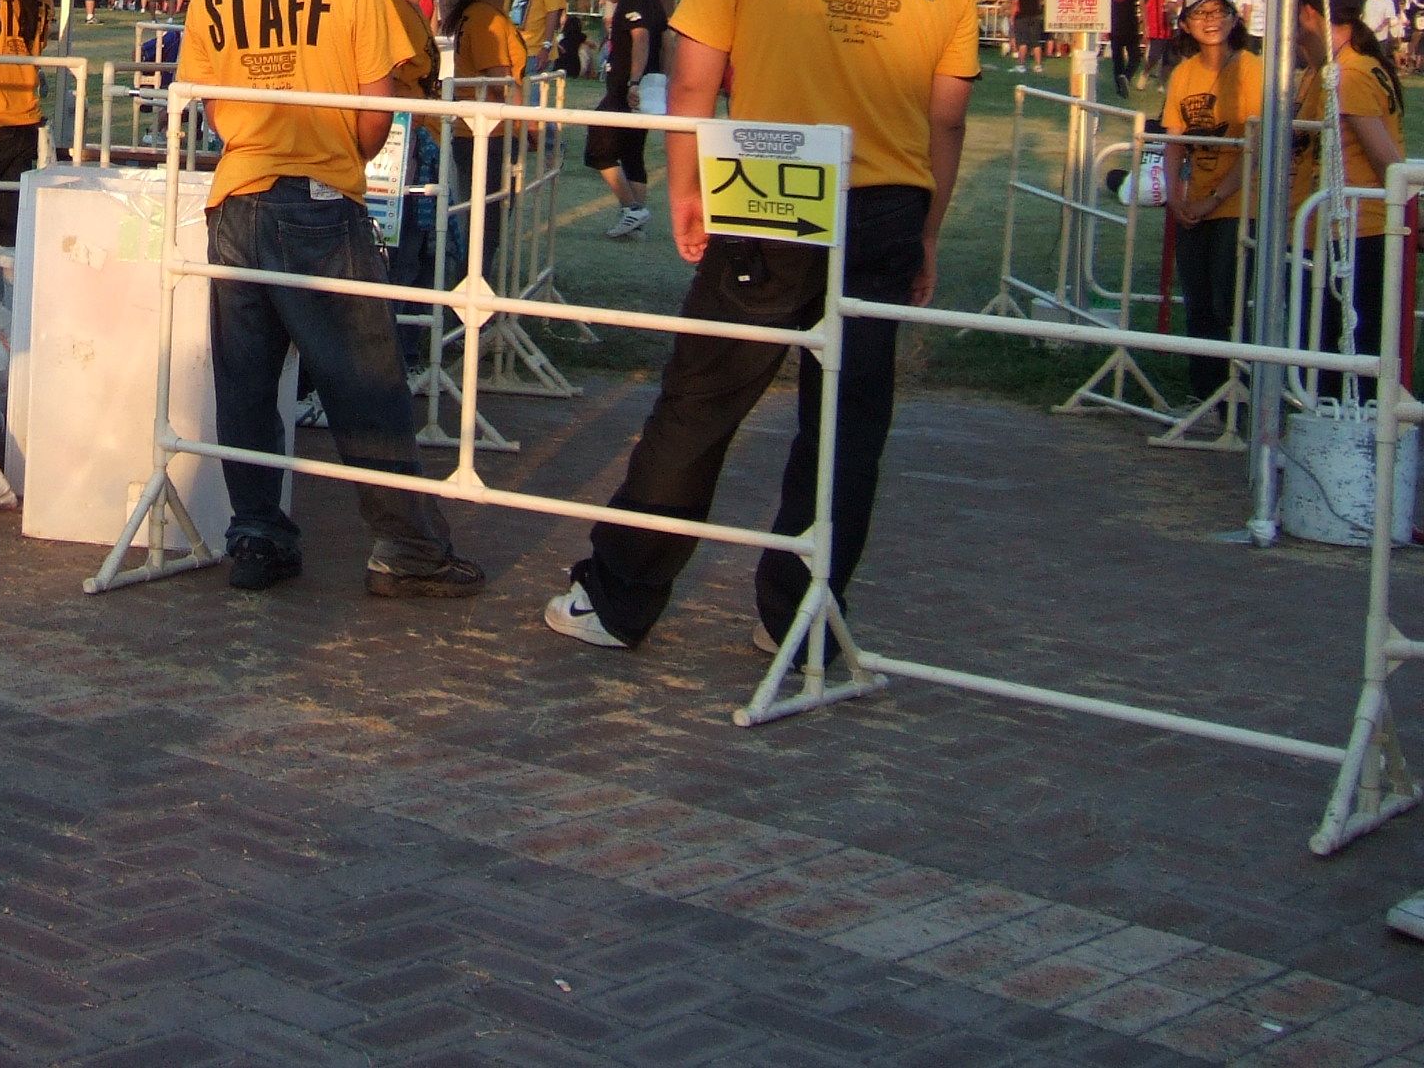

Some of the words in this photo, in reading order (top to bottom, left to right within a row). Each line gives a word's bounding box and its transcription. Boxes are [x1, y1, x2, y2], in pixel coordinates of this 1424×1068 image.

[734, 130, 804, 145] SUMMER
[742, 141, 796, 153] SONIC
[711, 157, 825, 201] 入口
[747, 199, 795, 216] ENTER
